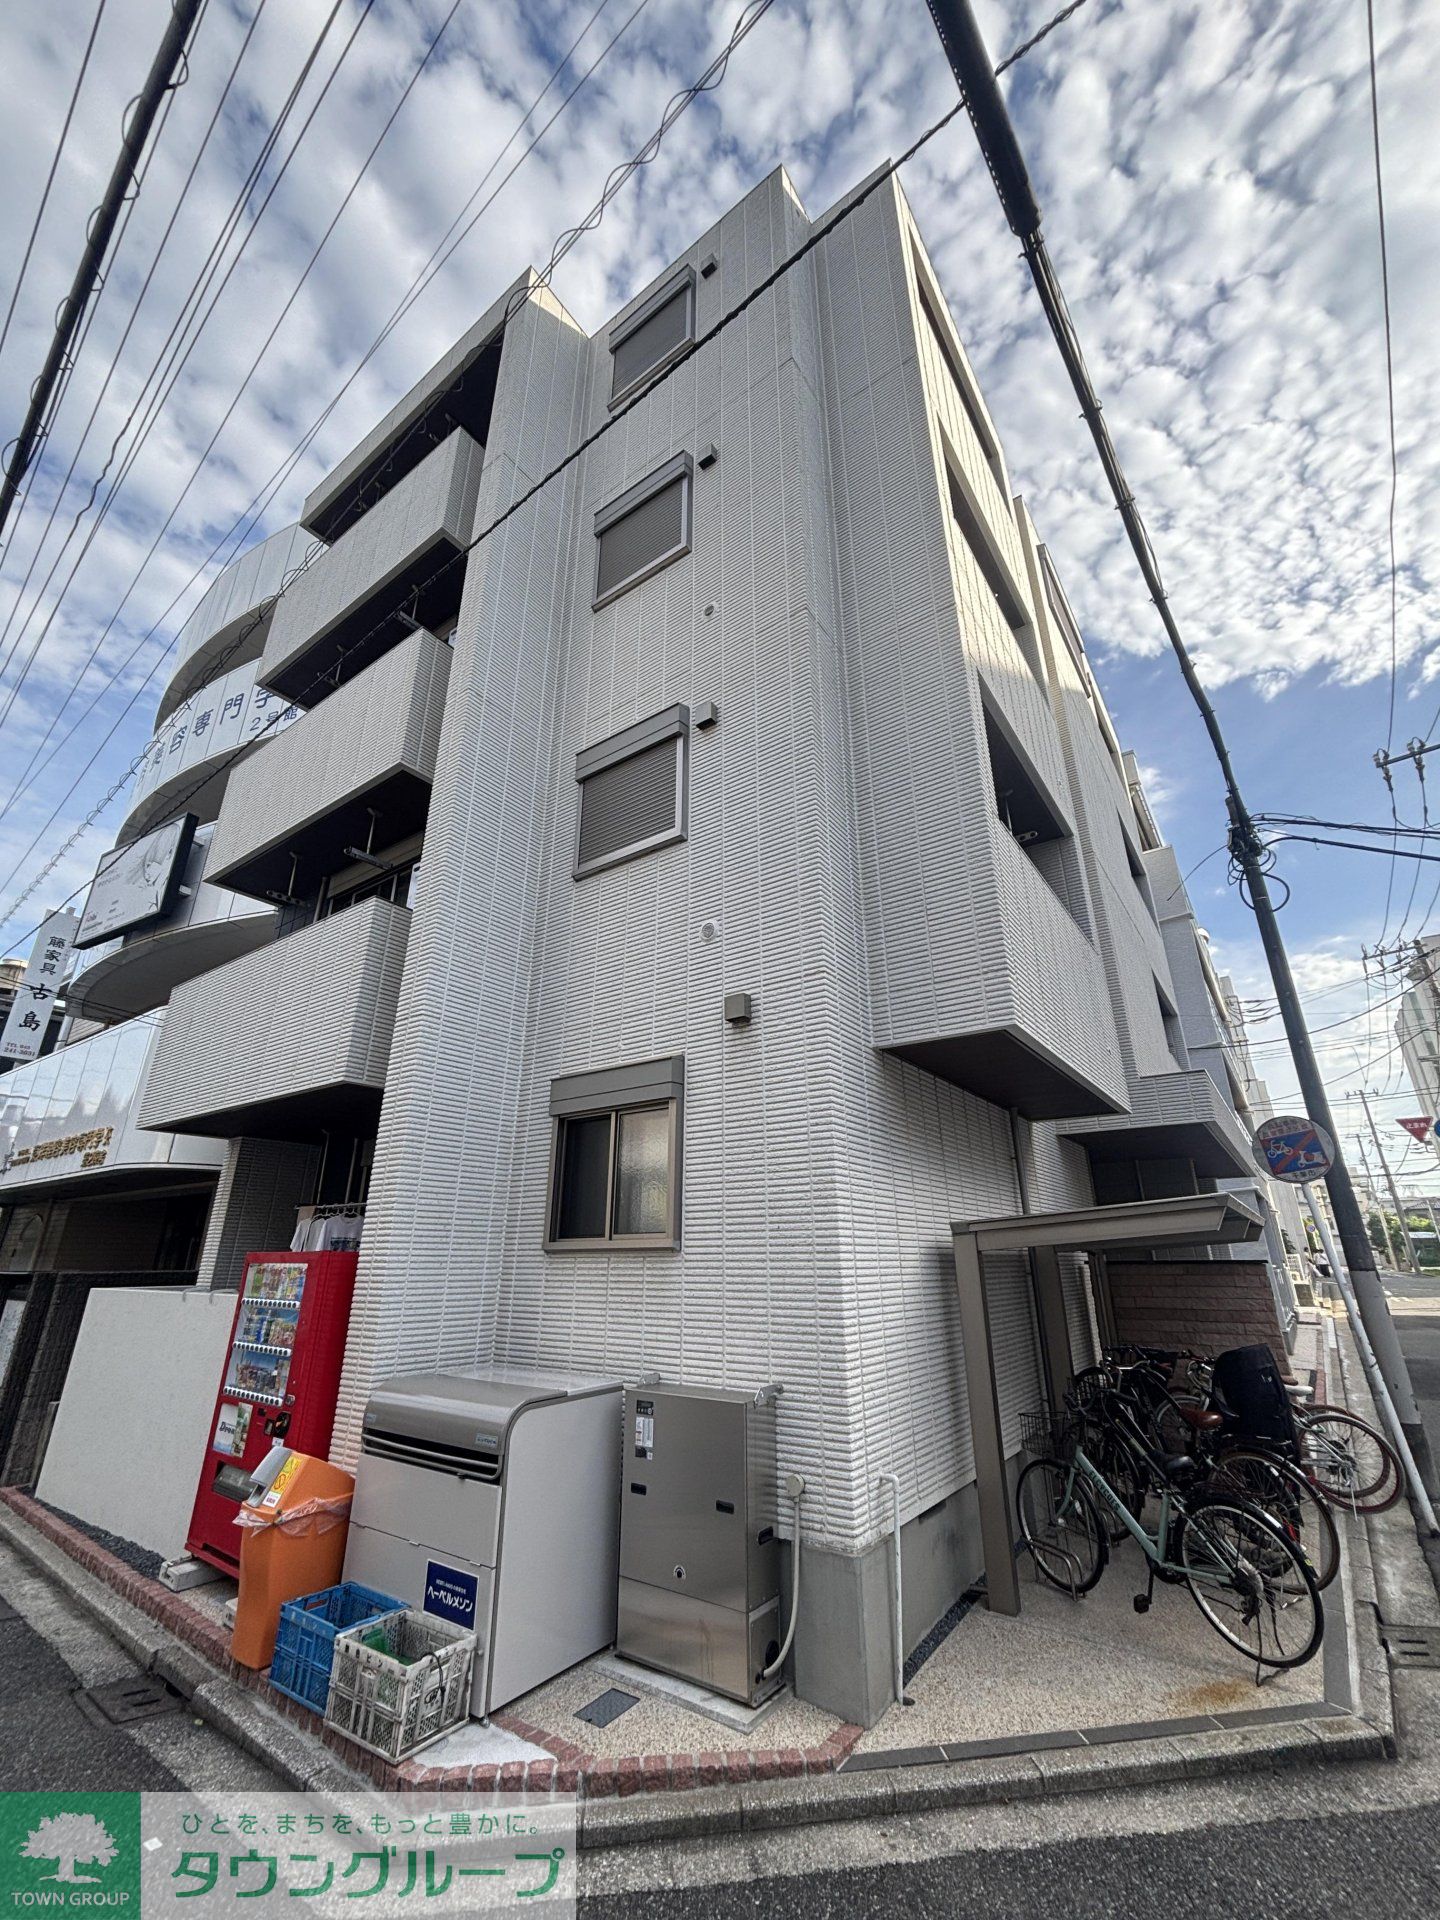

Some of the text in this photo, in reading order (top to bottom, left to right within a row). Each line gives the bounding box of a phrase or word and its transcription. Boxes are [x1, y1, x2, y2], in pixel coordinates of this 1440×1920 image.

[18, 983, 53, 1032] 古島
[427, 1586, 474, 1613] ヘーベルメゾン
